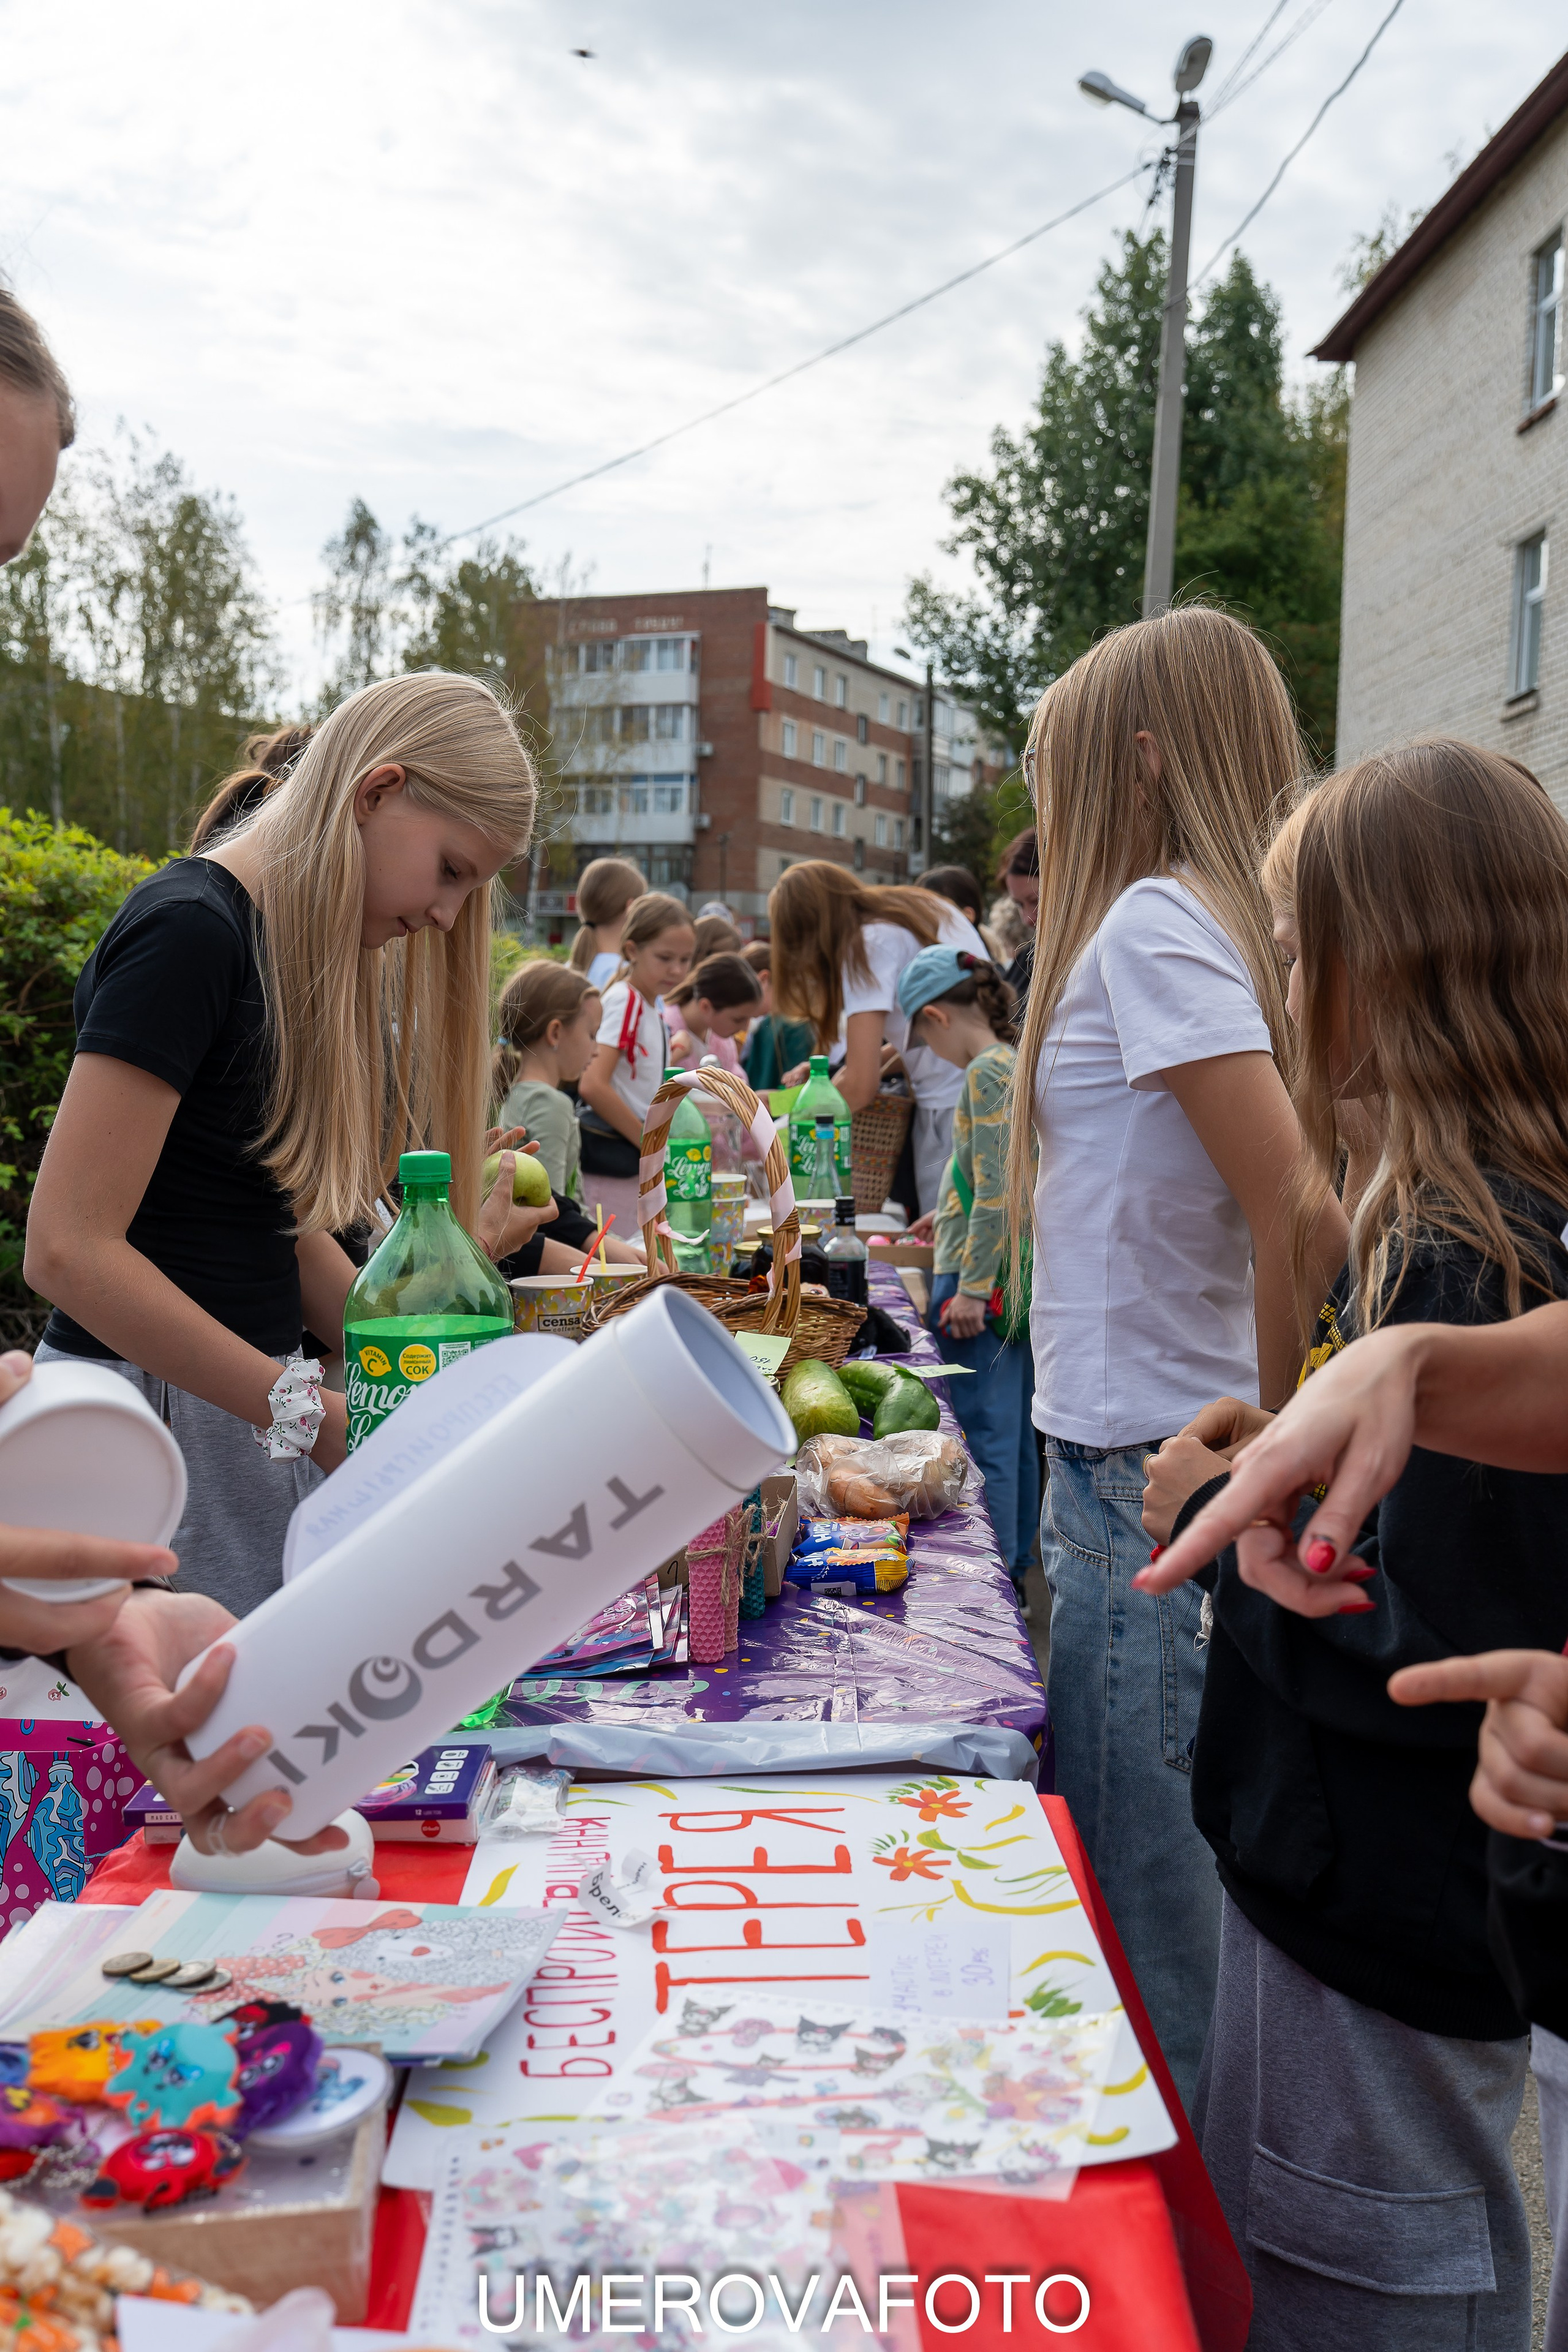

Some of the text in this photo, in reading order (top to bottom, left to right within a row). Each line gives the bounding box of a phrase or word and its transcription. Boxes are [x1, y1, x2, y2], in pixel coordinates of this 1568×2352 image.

[543, 1316, 581, 1327] censa
[364, 1349, 388, 1366] VITAMIN
[368, 1357, 377, 1373] C
[405, 1365, 429, 1376] СОК
[266, 1475, 665, 1786] TARDOKI
